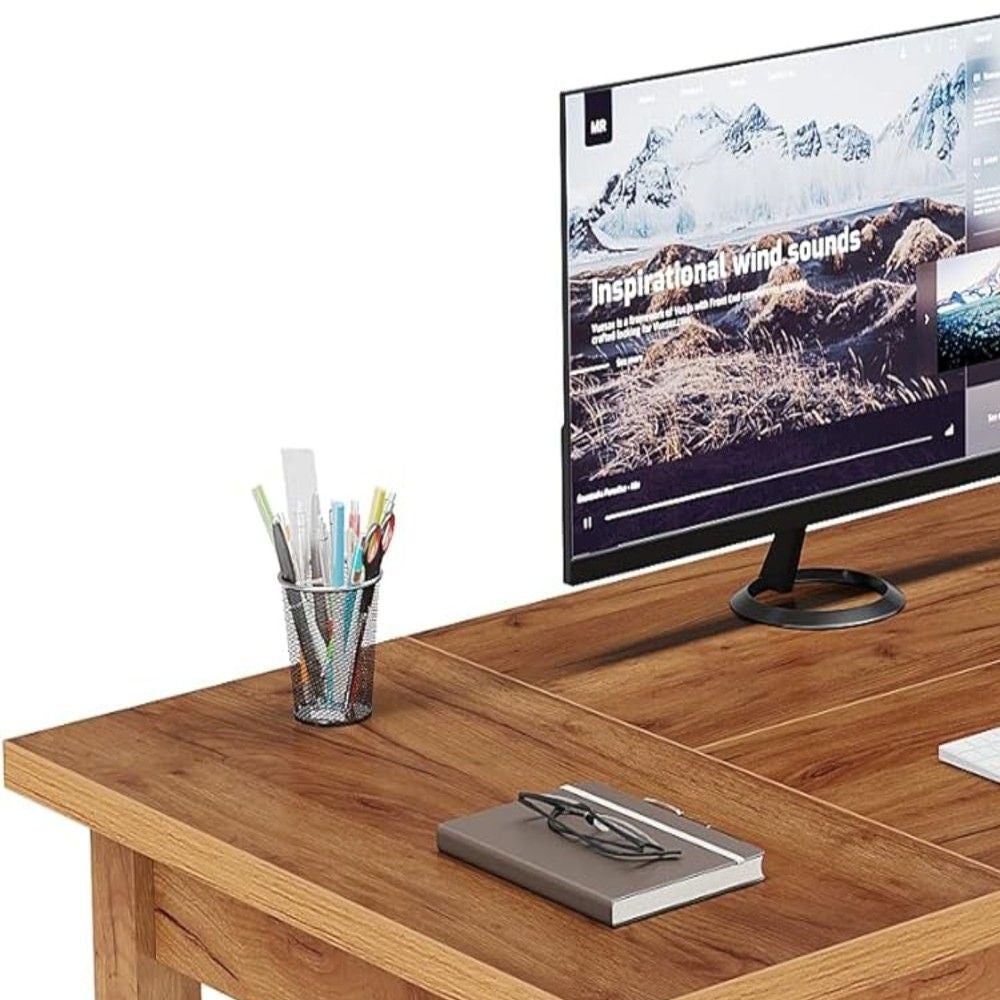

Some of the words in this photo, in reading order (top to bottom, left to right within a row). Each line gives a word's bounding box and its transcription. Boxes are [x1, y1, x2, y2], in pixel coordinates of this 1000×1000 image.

[590, 118, 607, 135] MR
[588, 251, 726, 313] Inspirational
[732, 238, 783, 278] wind
[786, 225, 861, 264] sounds
